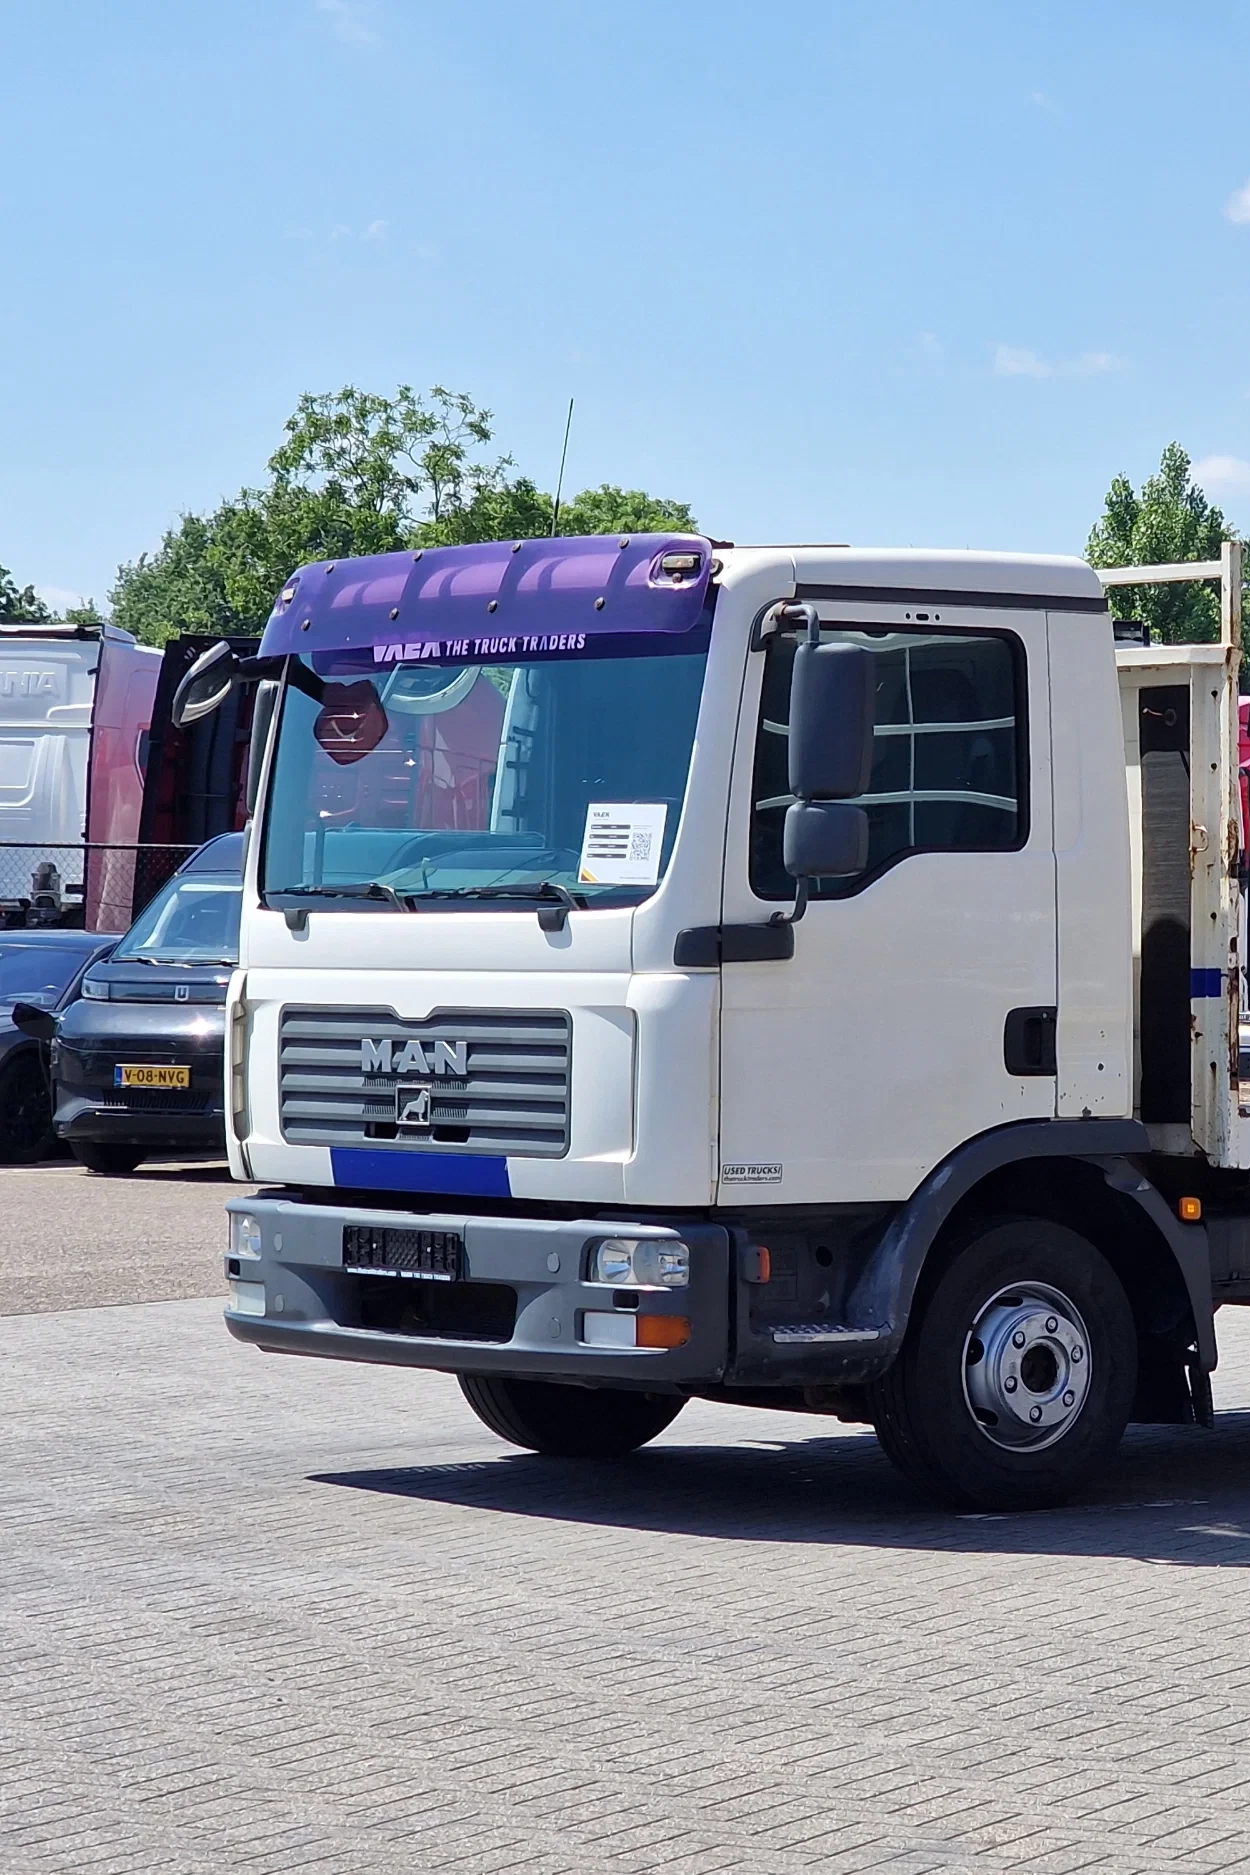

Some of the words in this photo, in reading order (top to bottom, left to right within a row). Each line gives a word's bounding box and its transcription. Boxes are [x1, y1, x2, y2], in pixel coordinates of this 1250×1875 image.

[445, 639, 470, 657] THE
[474, 637, 517, 654] TRUCK
[522, 634, 586, 652] TRADERS
[361, 1038, 467, 1075] MAN
[124, 1069, 185, 1084] V-08-NVG
[724, 1166, 746, 1175] USED
